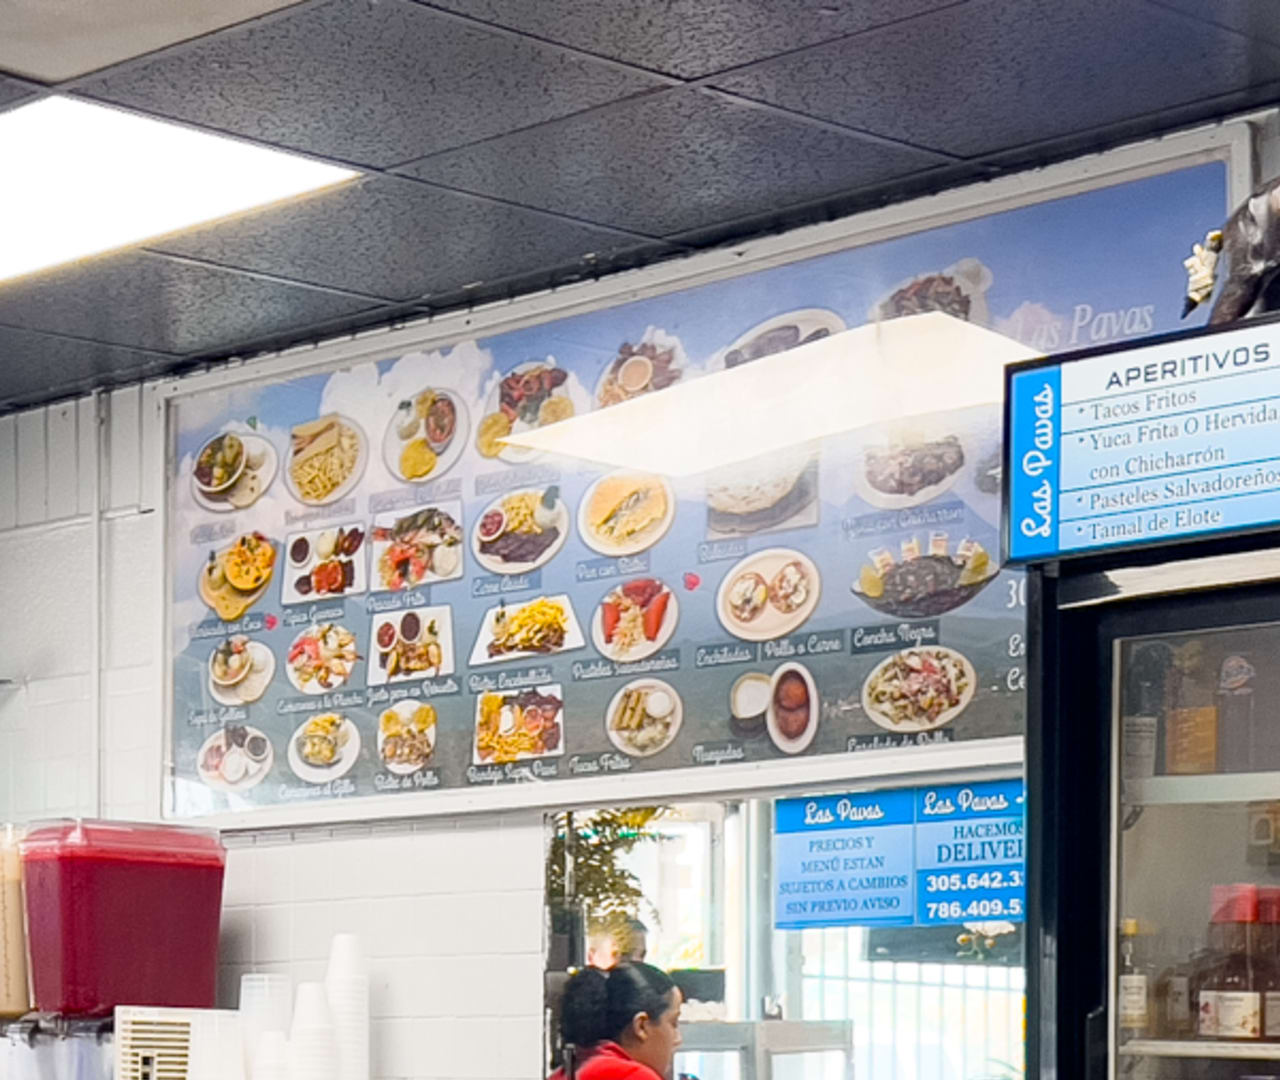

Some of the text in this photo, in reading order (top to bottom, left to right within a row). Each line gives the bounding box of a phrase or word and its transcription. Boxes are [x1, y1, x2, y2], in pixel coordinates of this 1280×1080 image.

[1069, 303, 1155, 345] Pavas
[1105, 342, 1271, 391] APERITIVOS
[1089, 389, 1198, 422] Tacos Fritos
[1088, 429, 1133, 452] Yuca
[1136, 420, 1180, 444] Frita
[1183, 416, 1200, 436] O
[1020, 382, 1055, 538] Las Pavas
[1089, 445, 1226, 481] con Chicharrón
[1089, 486, 1160, 511] Pasteles
[1088, 505, 1222, 542] Tamal de Elote
[853, 627, 896, 647] Concha
[803, 798, 886, 825] Las Pavas
[923, 788, 1009, 815] Las Pavas
[808, 835, 875, 853] PRECIOS Y
[778, 874, 909, 896] SUJETOS A CAMBIOS
[926, 870, 1023, 892] 305.642.3
[786, 896, 901, 915] SIN PREVIO AVISO
[926, 898, 1022, 919] 786.409.5
